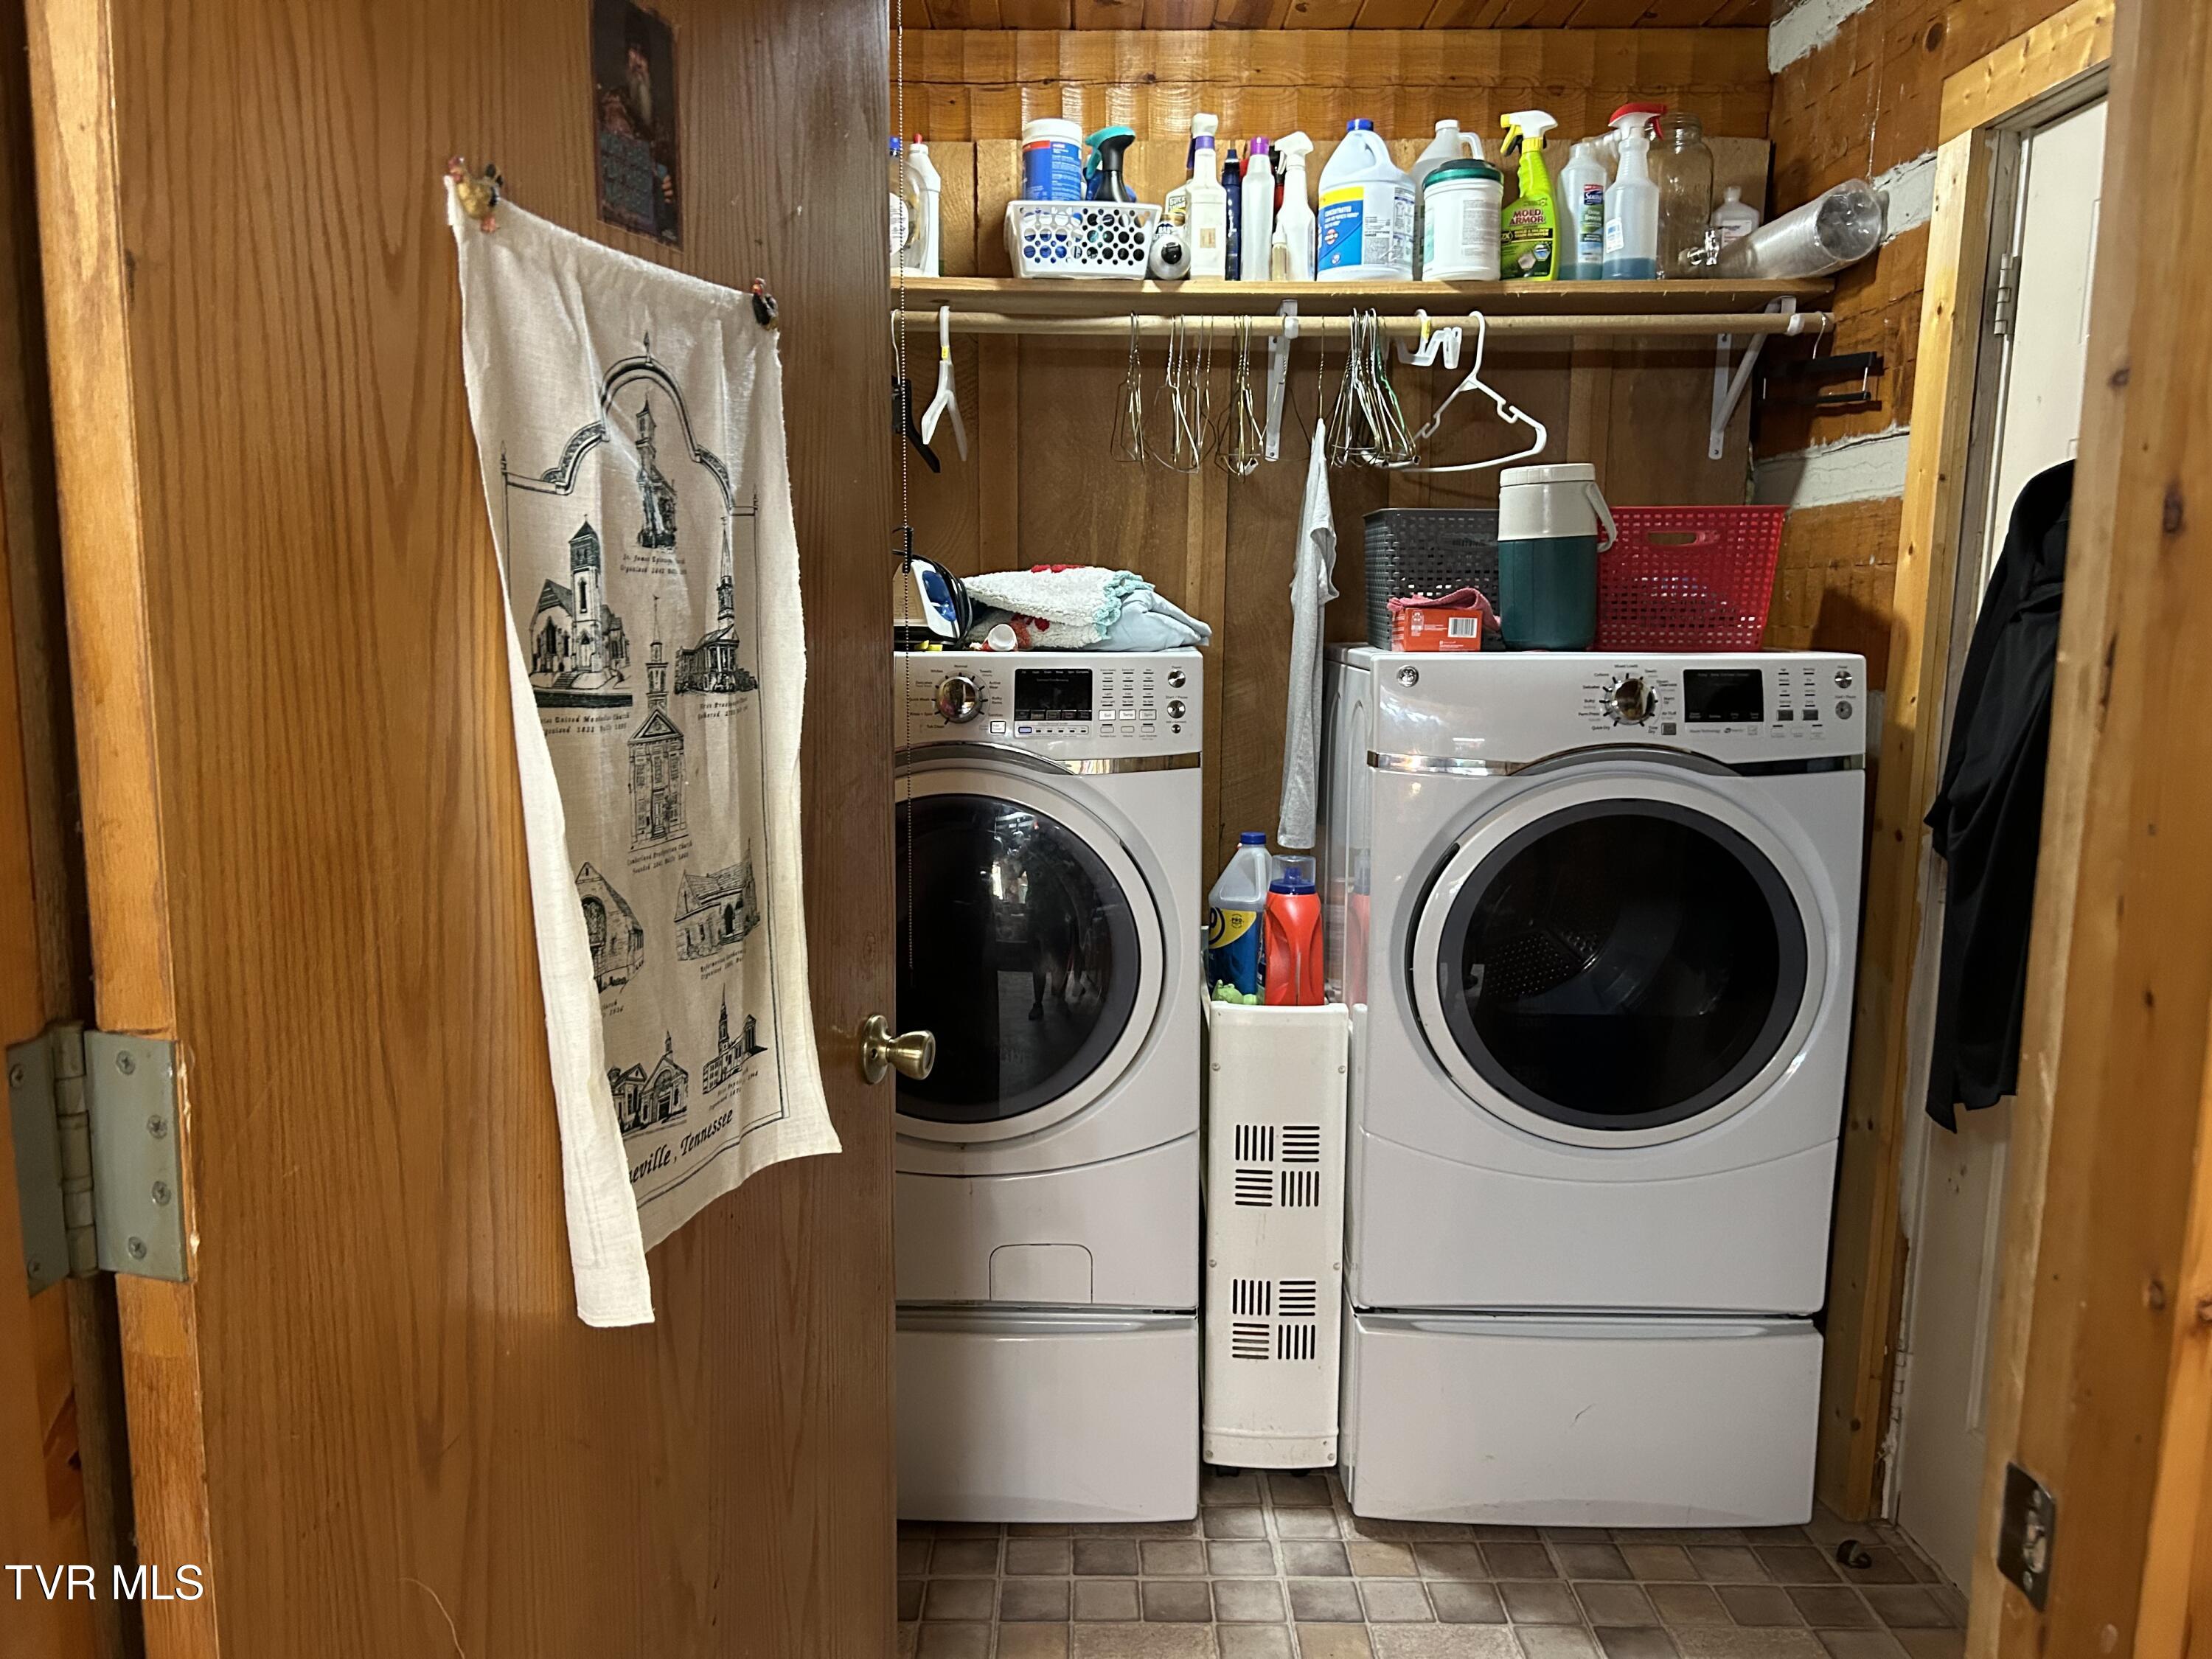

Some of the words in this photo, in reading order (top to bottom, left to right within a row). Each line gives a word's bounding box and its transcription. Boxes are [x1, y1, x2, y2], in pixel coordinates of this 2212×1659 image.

[1513, 209, 1541, 218] MOLD
[1510, 216, 1544, 224] ARMOR
[681, 1109, 733, 1156] Tennessee
